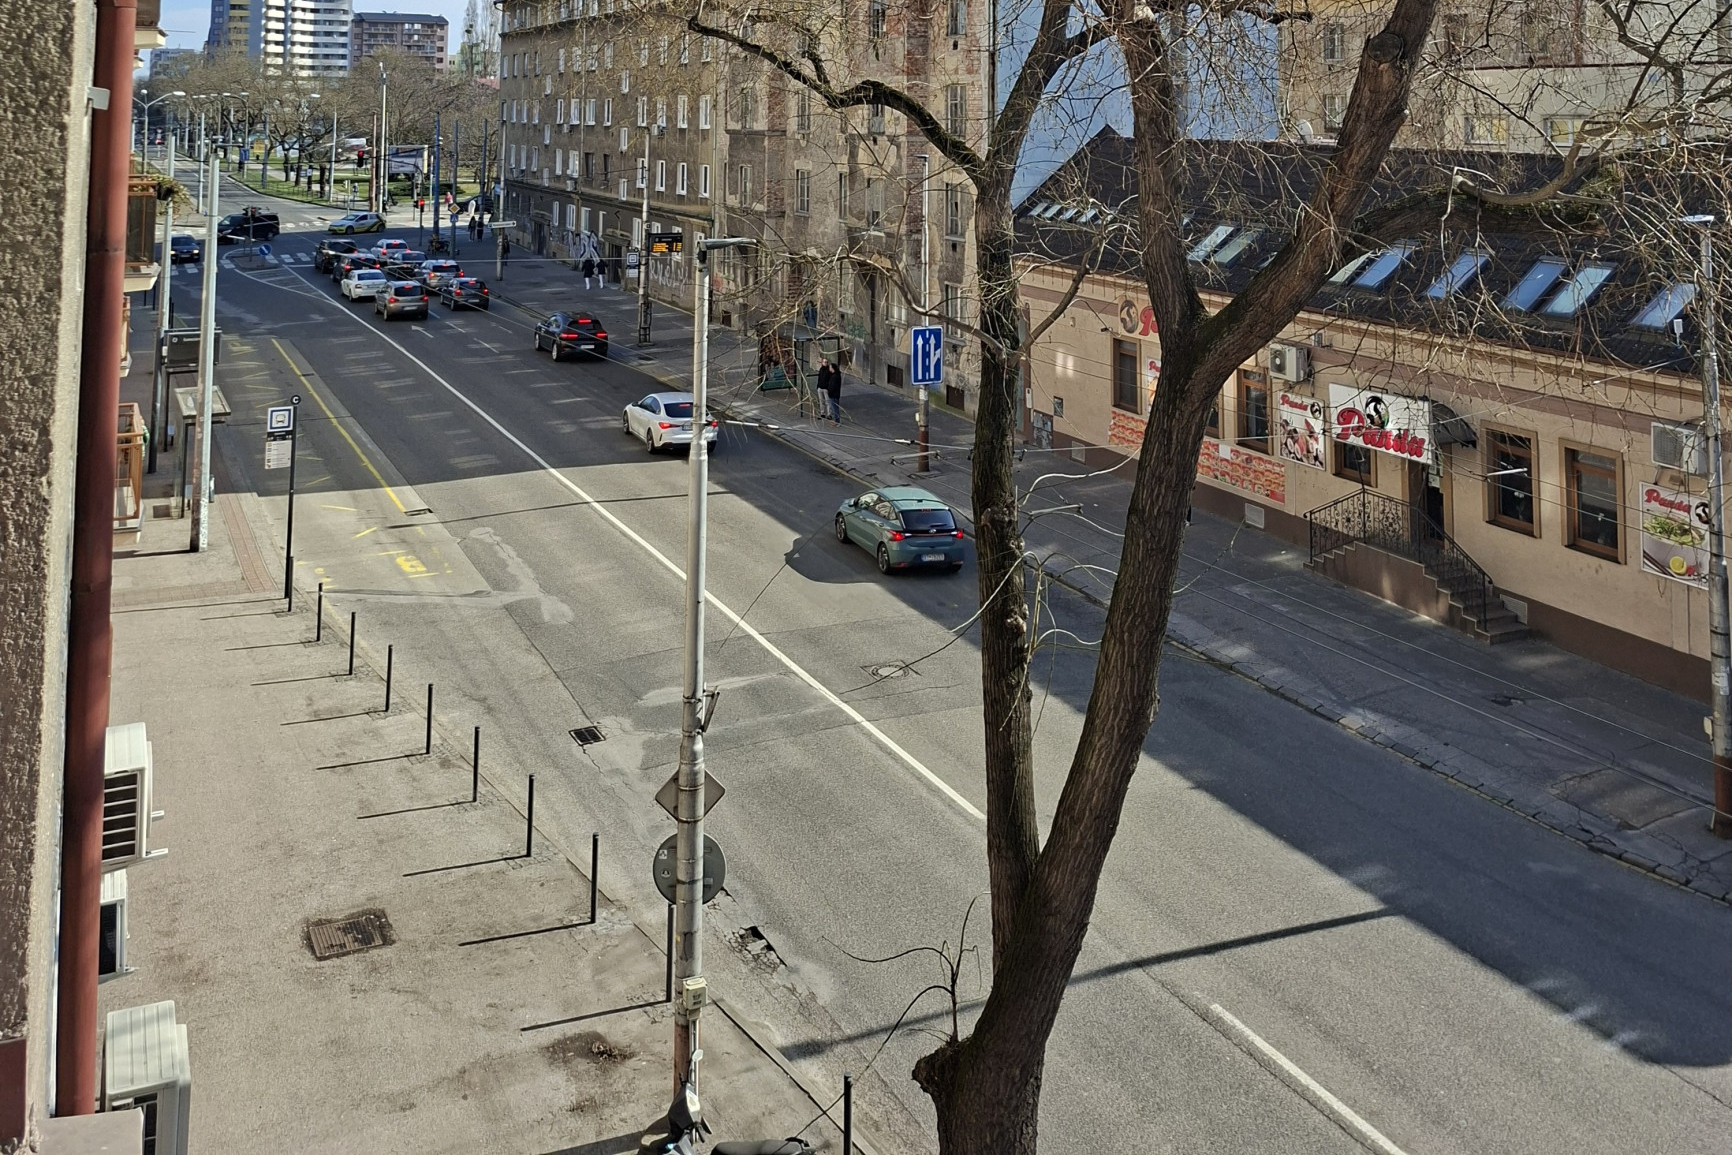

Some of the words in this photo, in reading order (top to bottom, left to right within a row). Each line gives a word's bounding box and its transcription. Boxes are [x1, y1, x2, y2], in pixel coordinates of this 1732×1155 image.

[292, 396, 299, 404] C
[1280, 394, 1309, 412] Panda
[1336, 407, 1426, 458] Panda
[1644, 488, 1692, 514] Panda
